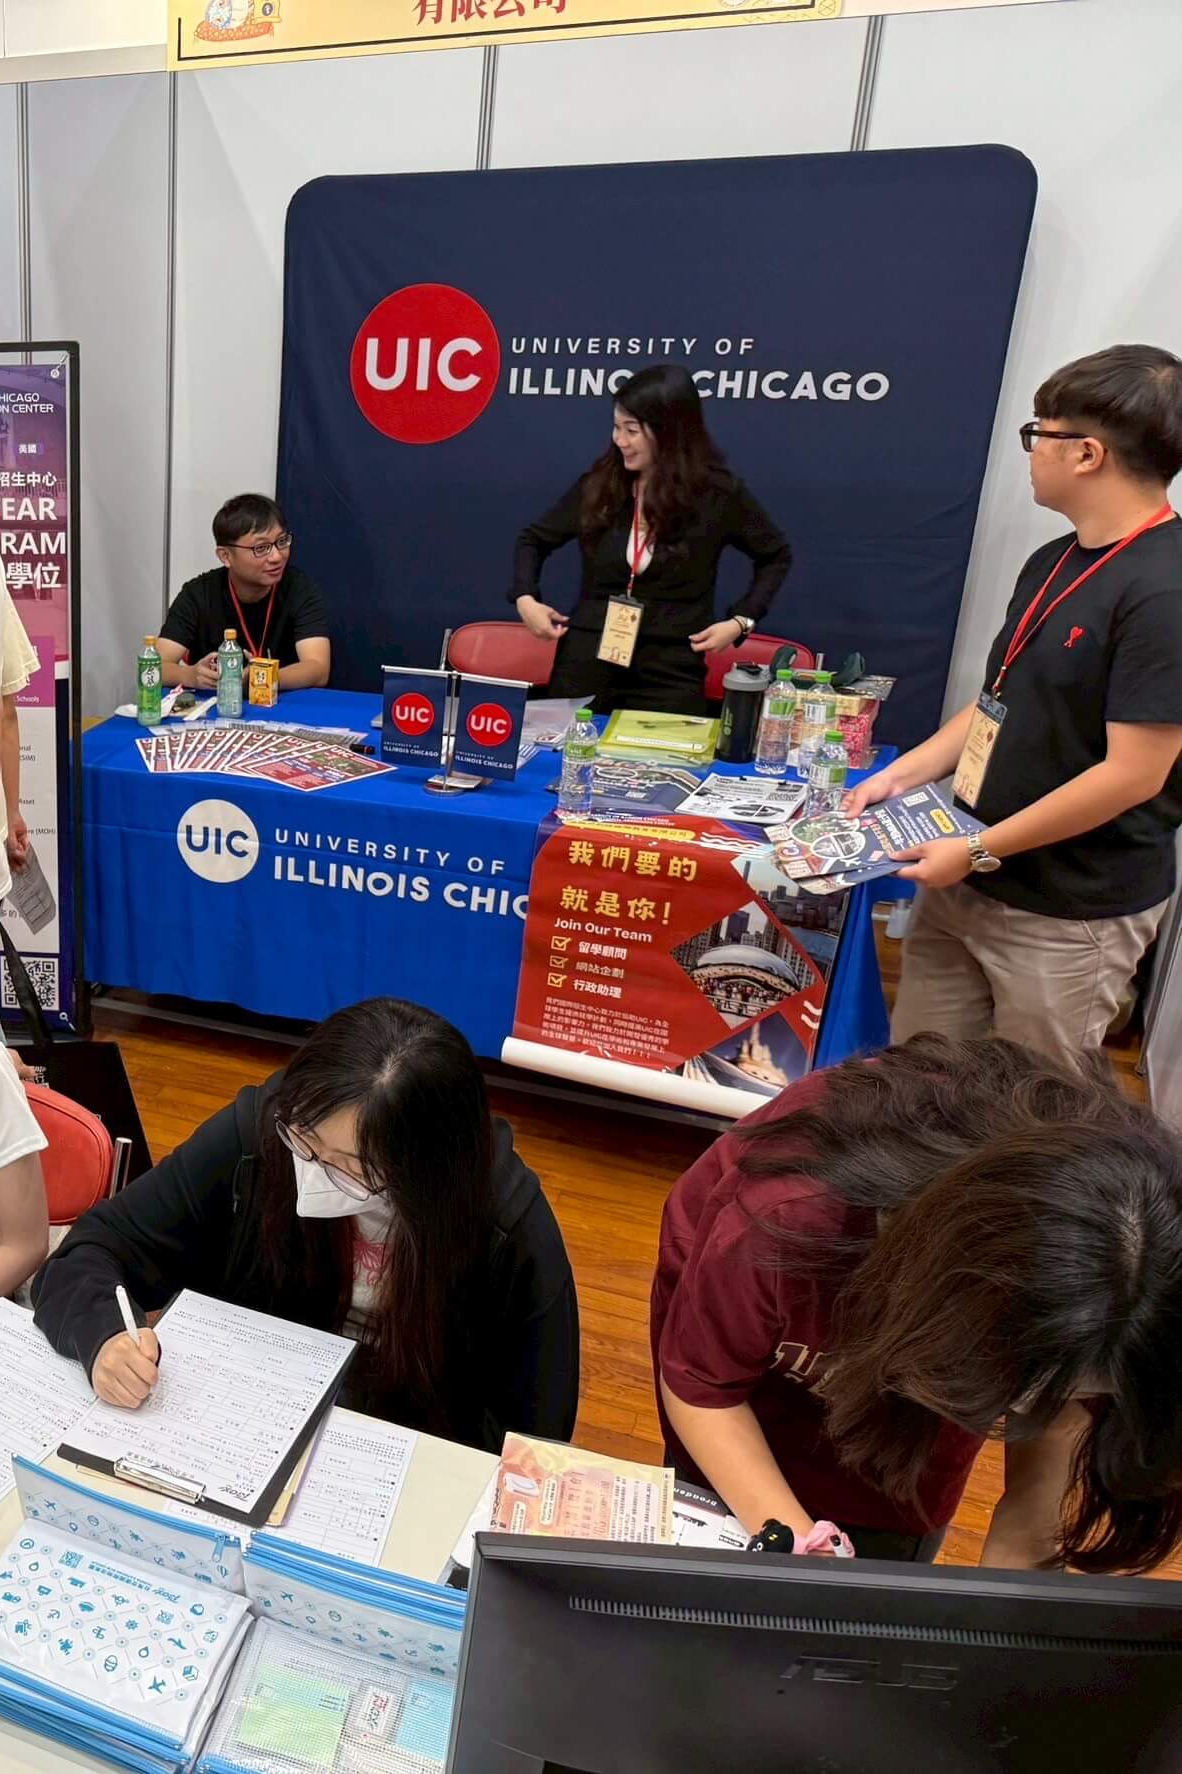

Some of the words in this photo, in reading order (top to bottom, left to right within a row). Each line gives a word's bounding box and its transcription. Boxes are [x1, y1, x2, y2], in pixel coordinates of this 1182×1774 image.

[510, 337, 698, 355] UNIVERSITY
[715, 338, 755, 356] OF
[364, 338, 482, 392] UIC
[696, 370, 890, 401] CHICAGO
[12, 404, 54, 413] CENTER
[6, 562, 61, 589] 學位
[395, 705, 429, 723] UIC
[470, 715, 507, 734] UIC
[383, 746, 409, 754] ILLINOIS
[410, 749, 438, 757] CHICAGO
[455, 755, 482, 765] ILLINOIS
[484, 760, 514, 769] CHICAGO
[185, 824, 250, 858] UIC
[275, 828, 451, 866] UNIVERSITY
[467, 857, 506, 875] OF
[569, 841, 697, 881] 我們要的
[274, 856, 429, 902] ILLINOIS
[560, 885, 670, 924] 就是你!
[554, 917, 581, 931] Join
[585, 923, 610, 936] Our
[613, 927, 652, 943] Team
[579, 941, 627, 960] 留學顧問
[573, 980, 622, 998] 行政助理
